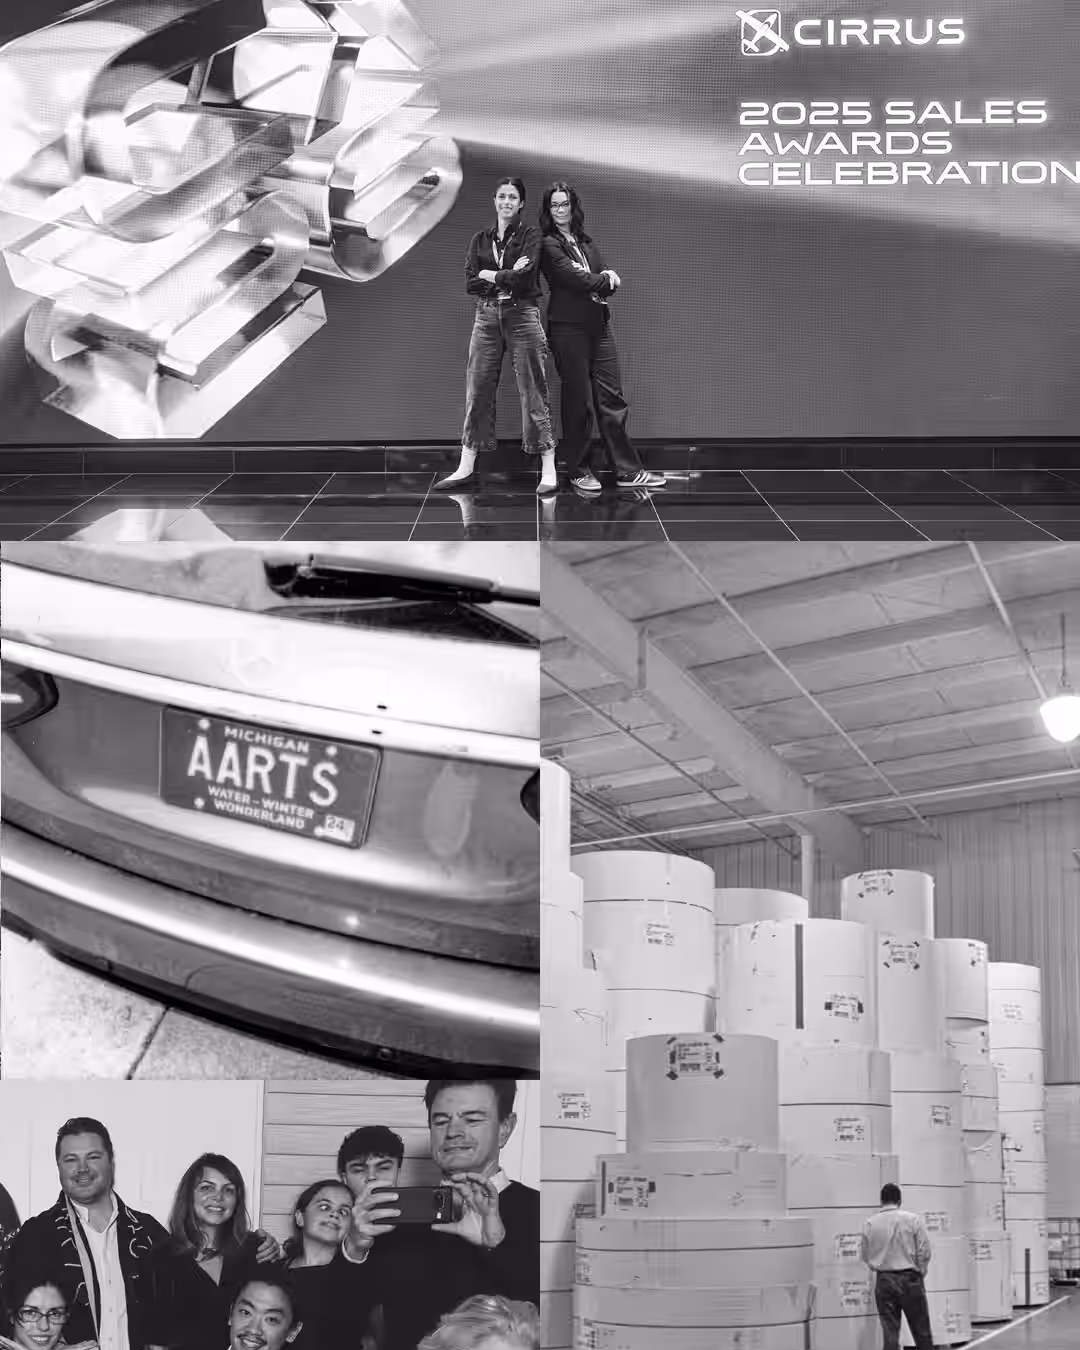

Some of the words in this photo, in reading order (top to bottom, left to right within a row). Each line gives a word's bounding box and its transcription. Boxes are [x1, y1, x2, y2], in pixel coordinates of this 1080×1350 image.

[793, 18, 966, 45] CIRRUS
[739, 101, 872, 125] 2025
[885, 100, 1048, 124] SALES
[737, 131, 953, 155] AWARDS
[738, 161, 1080, 186] CELEBRATION
[224, 725, 309, 753] MICHIGAN
[187, 735, 339, 806] AARTS
[208, 785, 251, 804] WATER
[261, 797, 314, 819] WINTER
[214, 799, 305, 829] WONDERLAND
